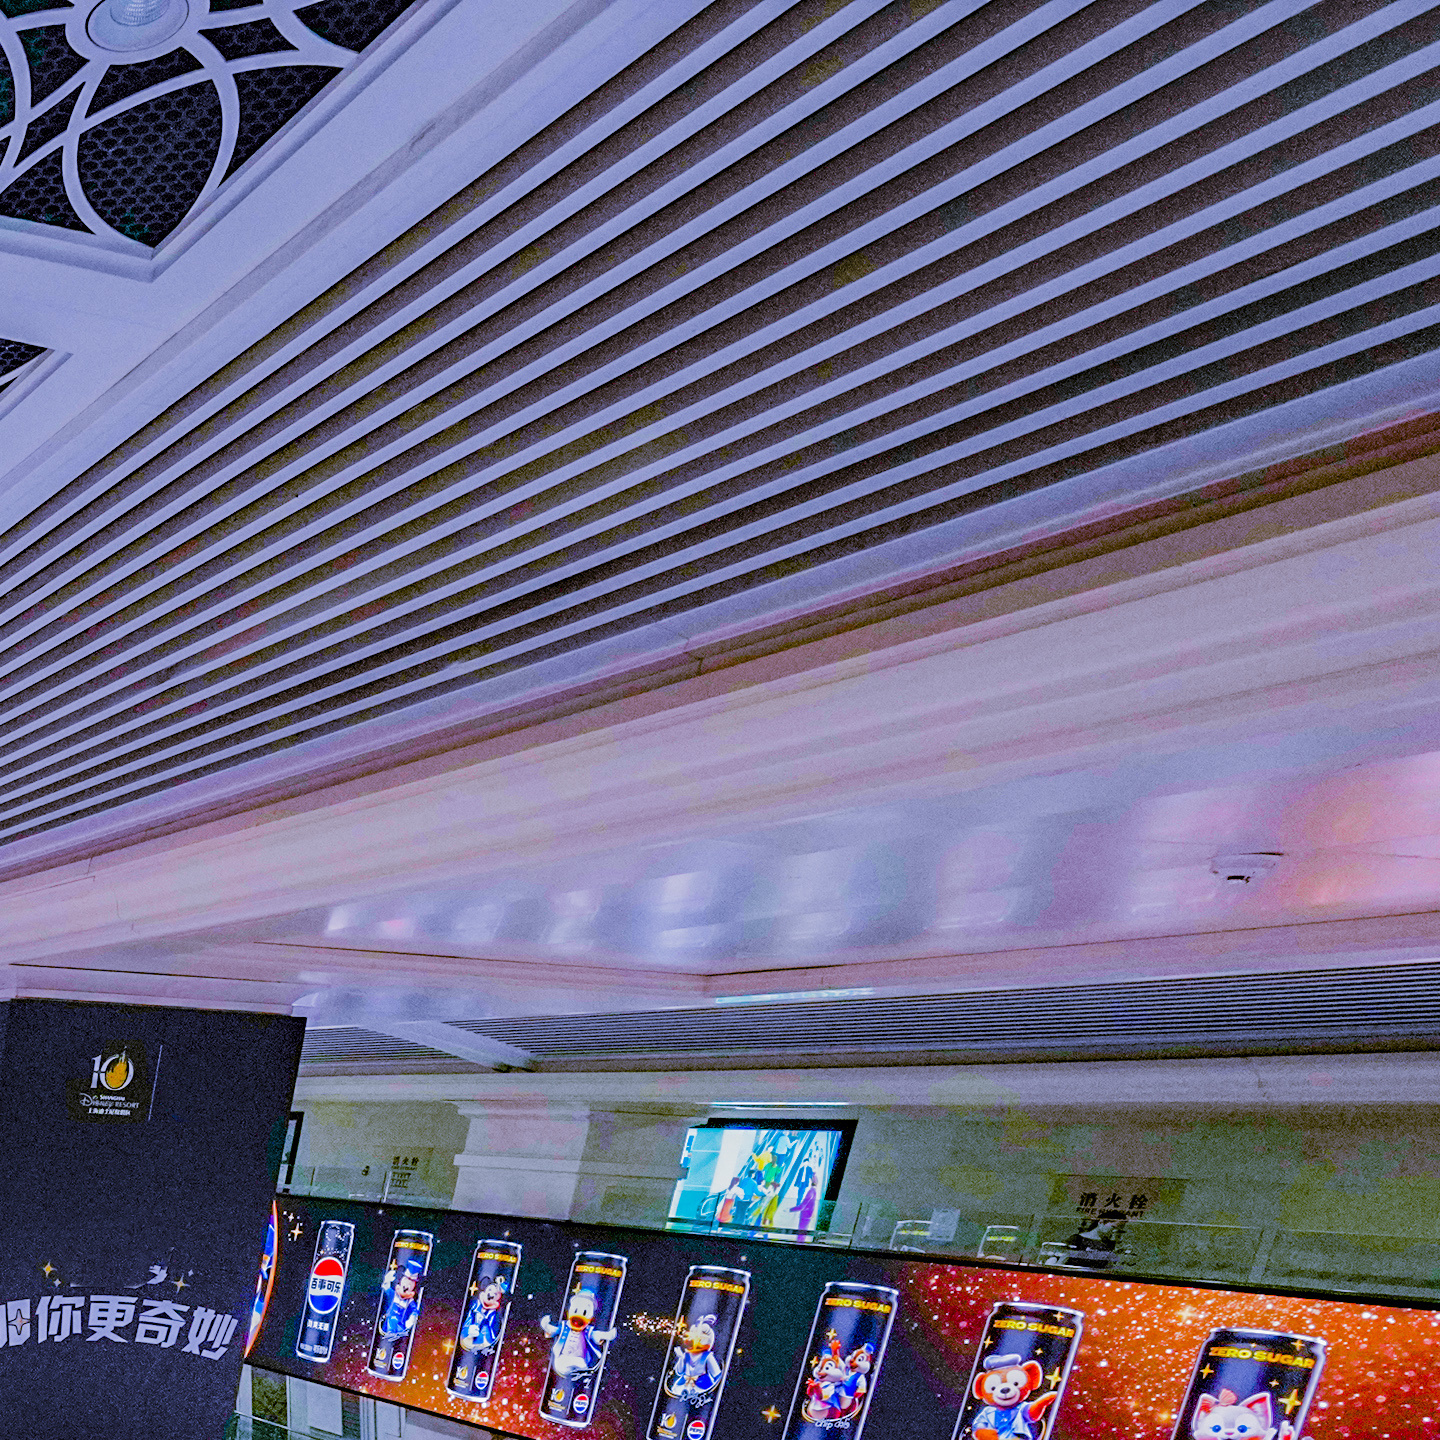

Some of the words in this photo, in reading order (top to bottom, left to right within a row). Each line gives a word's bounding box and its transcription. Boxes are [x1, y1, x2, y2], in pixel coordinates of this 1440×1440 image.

[1079, 1192, 1149, 1210] 消火栓
[311, 1278, 341, 1294] 百事可乐
[689, 1280, 712, 1289] ZERO
[825, 1298, 852, 1307] ZERO
[853, 1300, 892, 1314] SUGAR
[993, 1319, 1027, 1332] ZERO
[1027, 1321, 1075, 1339] SUGAR
[1208, 1346, 1254, 1360] ZERO
[1254, 1350, 1316, 1369] SUGAR
